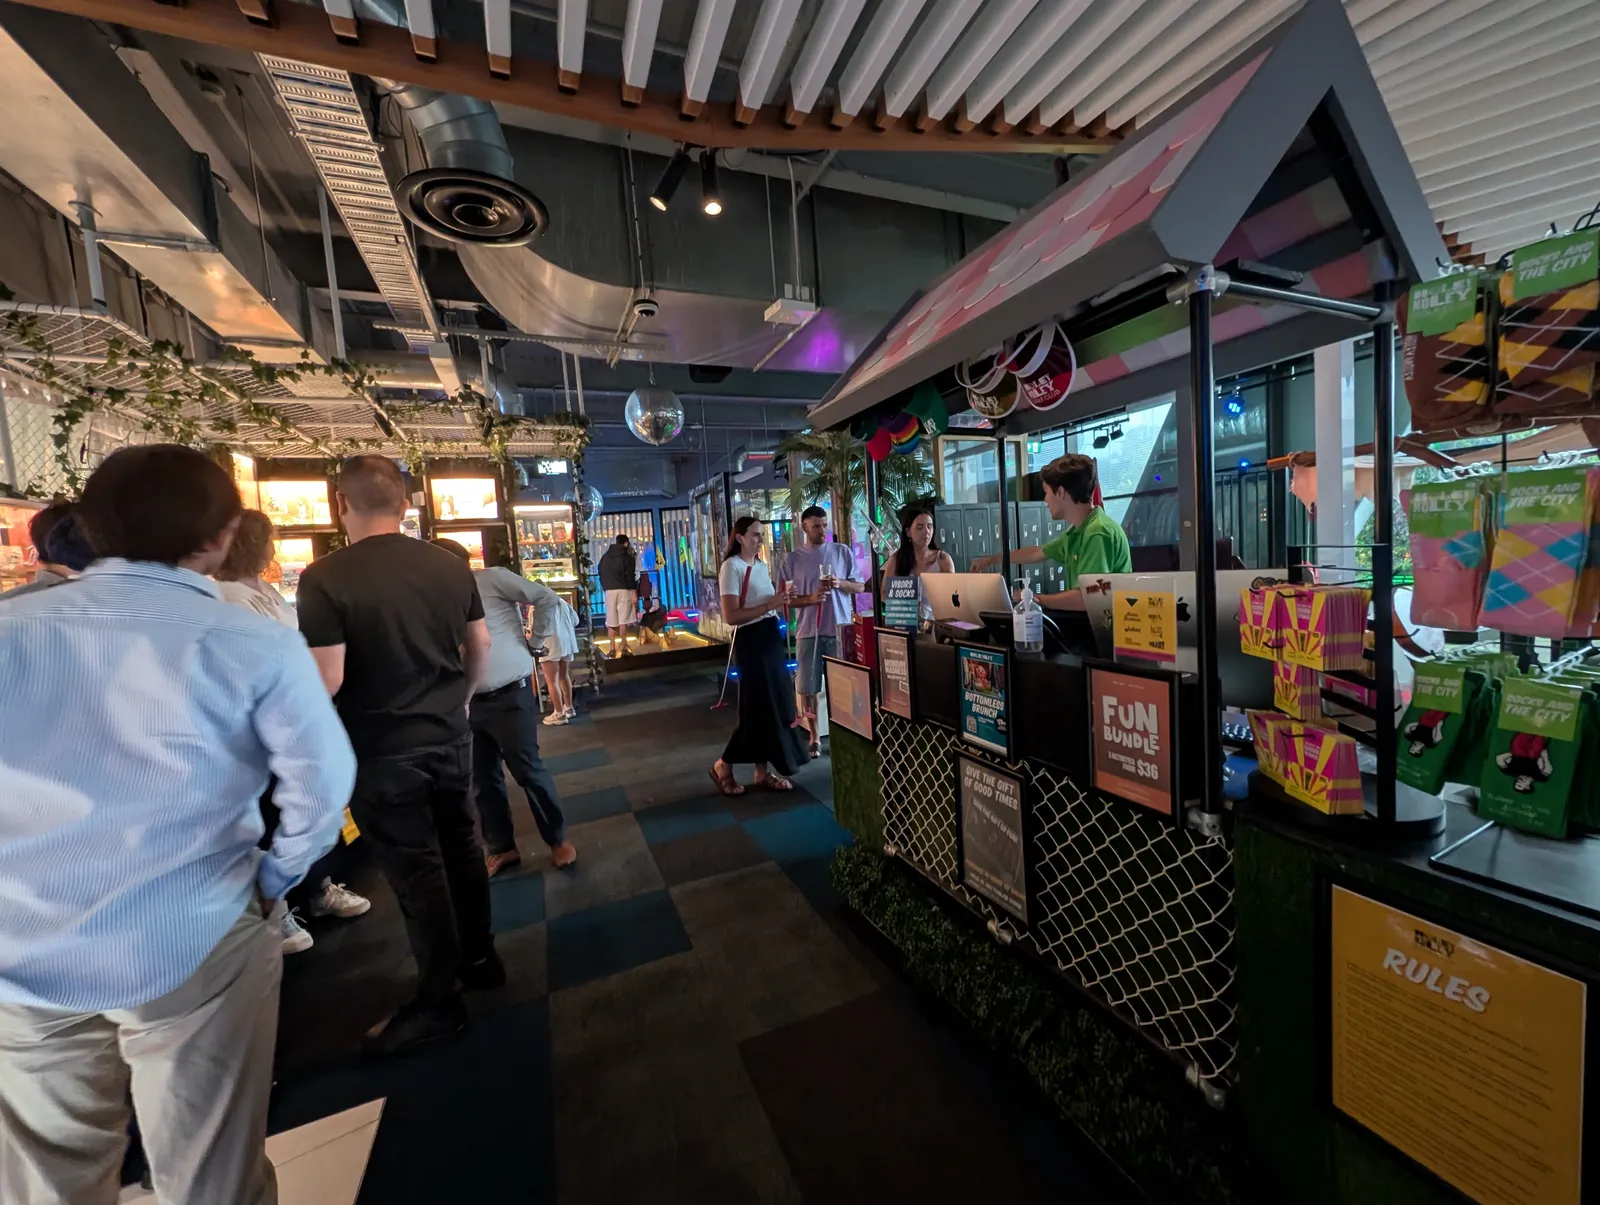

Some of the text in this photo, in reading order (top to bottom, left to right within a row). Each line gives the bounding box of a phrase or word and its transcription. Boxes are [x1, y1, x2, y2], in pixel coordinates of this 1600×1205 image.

[1519, 250, 1592, 282] THE CITY
[1509, 493, 1578, 508] THE CITY
[891, 580, 914, 588] VISORS
[895, 589, 915, 597] SOCKS
[1416, 684, 1459, 698] THE CITY
[965, 692, 1004, 711] BOTTOMLESS
[972, 703, 998, 719] BRUNCH
[1546, 700, 1575, 711] AND
[1102, 695, 1158, 734] FUN
[1504, 704, 1571, 723] THE CITY
[1104, 725, 1160, 756] BUNDLE
[1136, 758, 1159, 781] $36
[965, 765, 1016, 796] GIVE THE GIFT
[964, 776, 1019, 811] OF GOOD TIMES
[1383, 947, 1492, 1014] RULES
